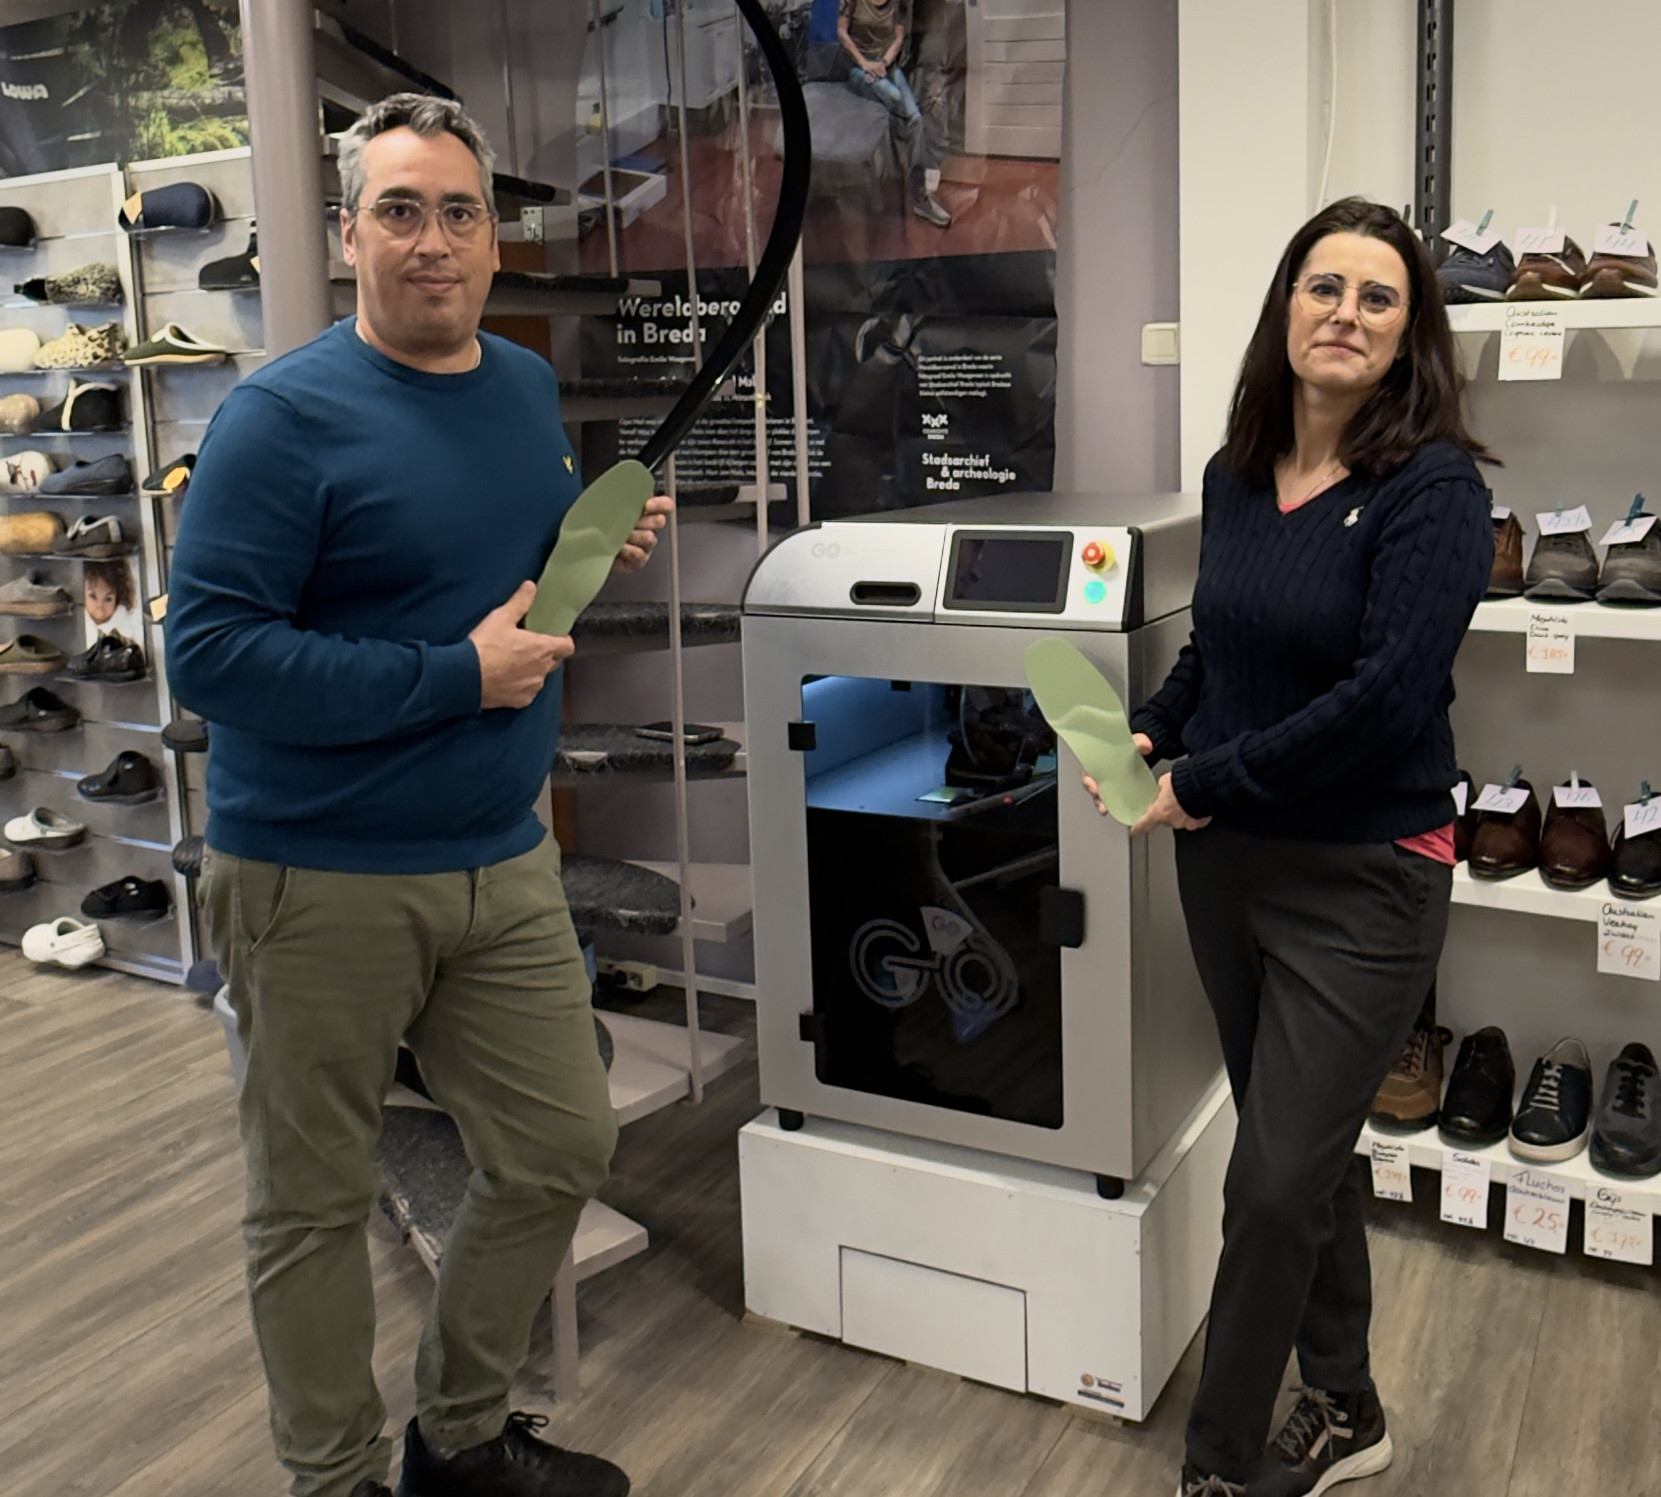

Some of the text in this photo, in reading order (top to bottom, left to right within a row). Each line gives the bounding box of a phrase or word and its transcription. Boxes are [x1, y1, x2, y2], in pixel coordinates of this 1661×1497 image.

[618, 291, 787, 318] Wereldberod
[617, 323, 706, 344] in Breda
[921, 452, 990, 467] Stadsarchief
[926, 477, 960, 490] Breda
[941, 466, 1016, 484] & archeologie
